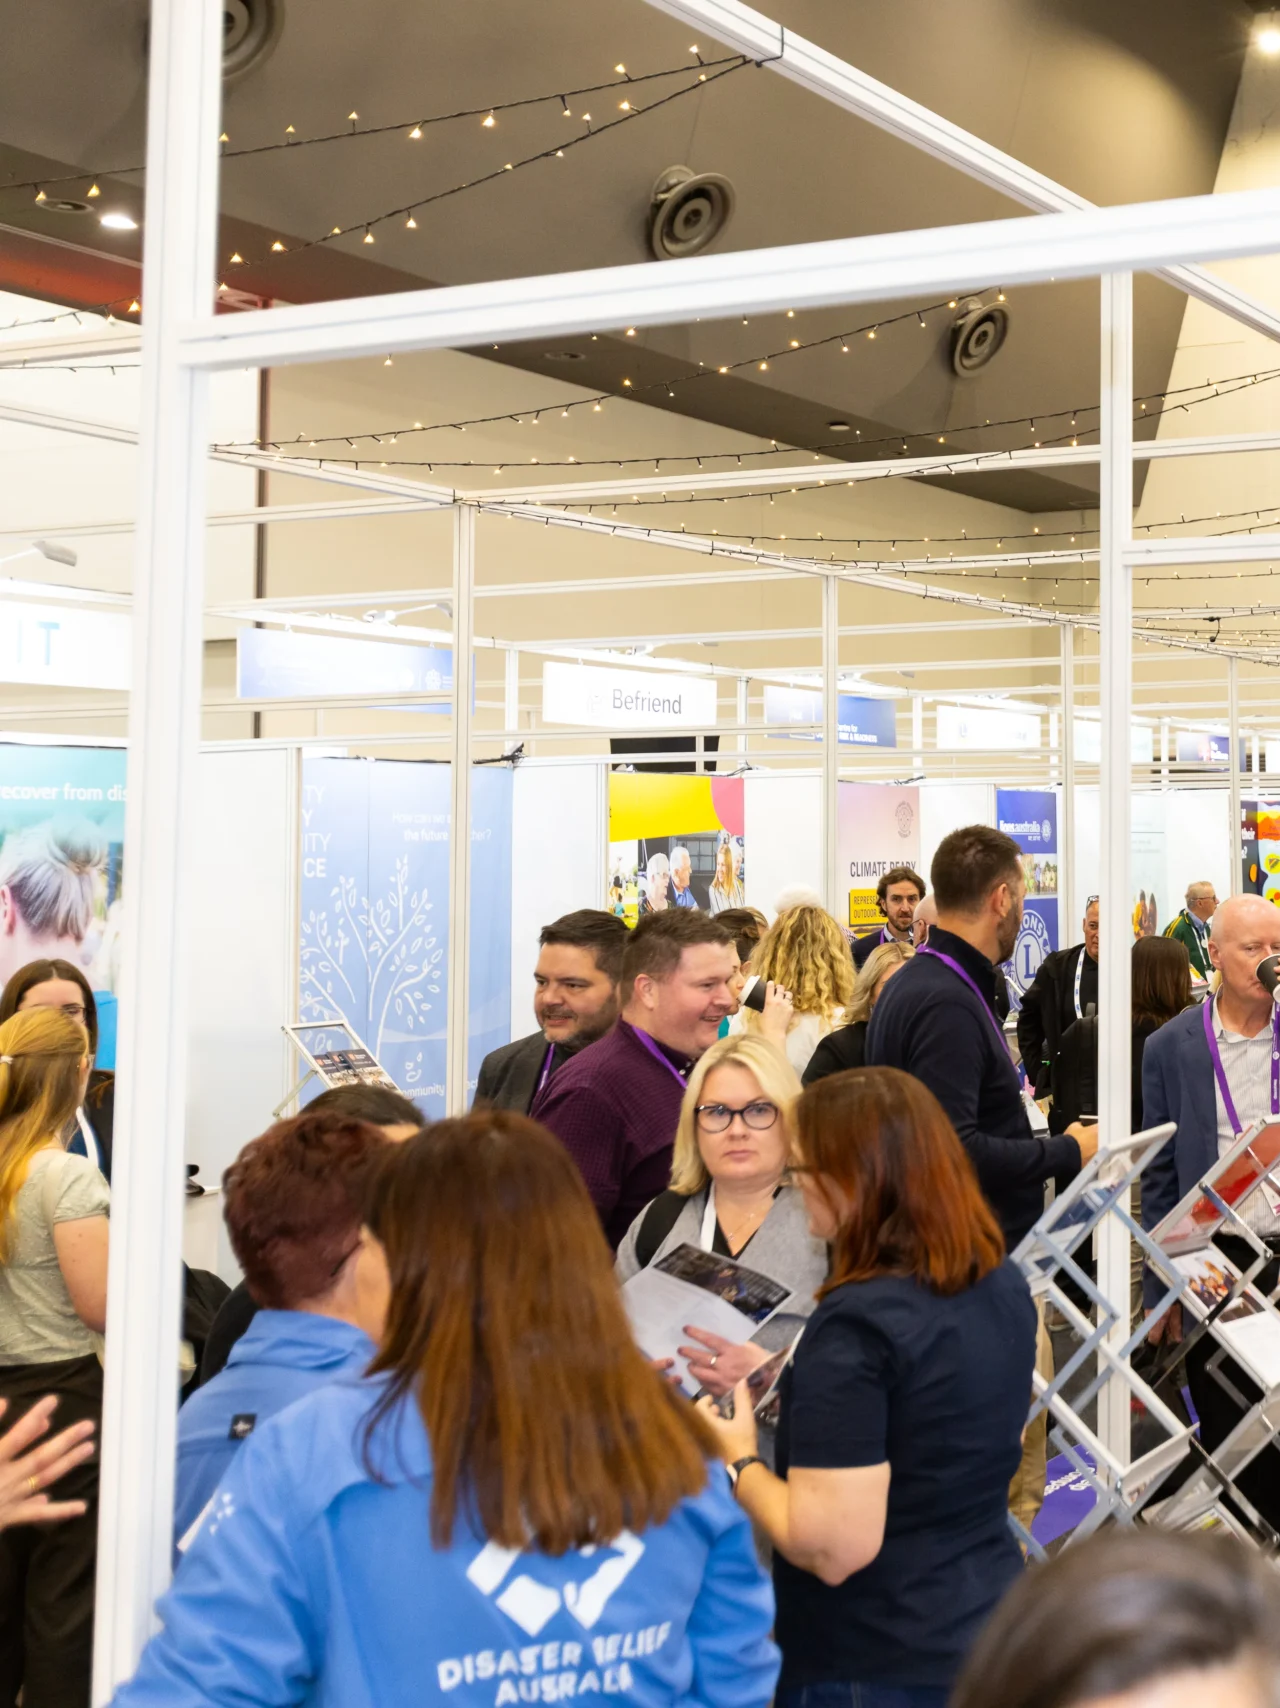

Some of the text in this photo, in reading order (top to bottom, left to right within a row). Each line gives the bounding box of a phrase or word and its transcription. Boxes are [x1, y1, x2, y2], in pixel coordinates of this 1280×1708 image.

[612, 688, 682, 715] Befriend
[0, 785, 59, 801] ecover
[62, 782, 104, 801] from
[850, 861, 887, 877] CLIMATE
